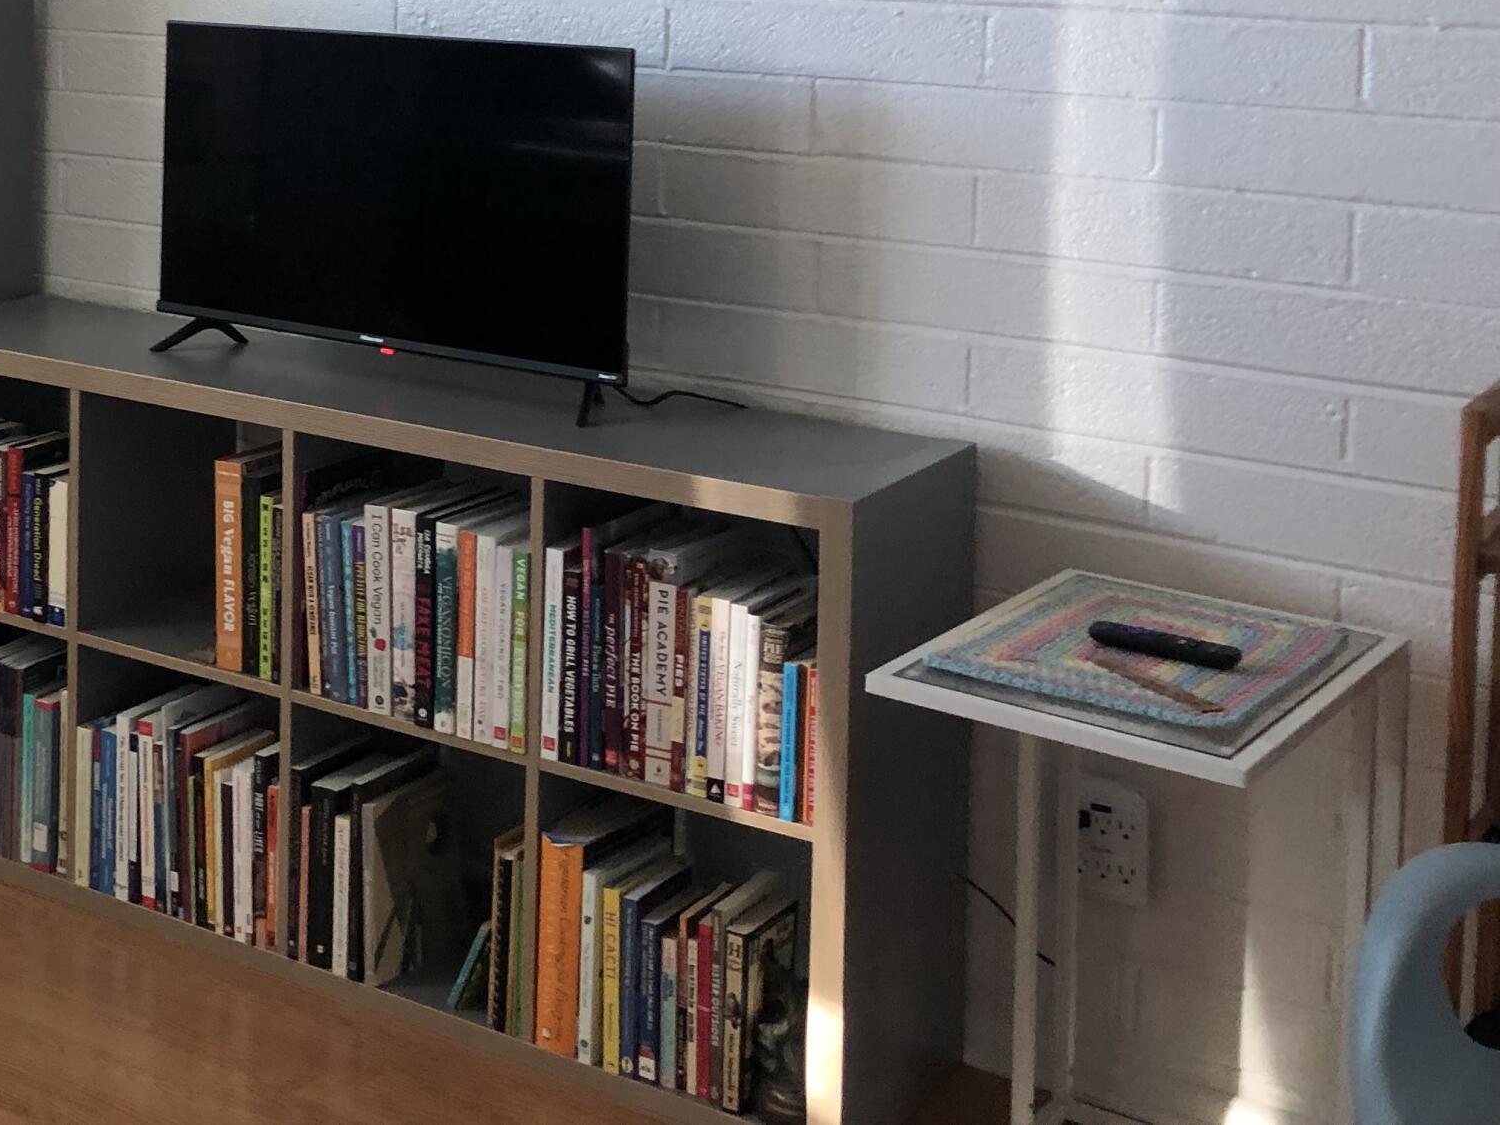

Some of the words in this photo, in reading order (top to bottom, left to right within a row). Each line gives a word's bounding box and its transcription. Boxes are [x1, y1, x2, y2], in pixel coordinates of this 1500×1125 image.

[33, 497, 42, 550] Generation
[223, 500, 234, 523] BIG
[371, 523, 382, 548] Can
[33, 552, 42, 581] Dread
[221, 529, 234, 575] Vegan
[372, 551, 384, 583] Cook
[355, 561, 366, 596] APPETITE
[515, 558, 526, 600] VEGAN
[223, 579, 234, 632] FLAVOR
[327, 584, 336, 609] Vegan
[356, 598, 366, 612] FOR
[371, 587, 383, 624] Vegan
[499, 583, 507, 614] VEGAN
[566, 595, 576, 621] HOW
[657, 589, 669, 614] PIE
[416, 597, 432, 635] FAKE
[441, 575, 453, 688] VEGANOMICON
[515, 611, 525, 635] FOR
[566, 623, 576, 637] TO
[356, 615, 366, 656] REDUCTION
[547, 604, 557, 694] MEDITERRANEAN
[700, 635, 708, 660] UNITED
[416, 641, 433, 688] MEAT
[565, 638, 575, 667] GRILL
[605, 625, 619, 680] perfect
[630, 651, 640, 673] THE
[656, 621, 668, 697] ACADEMY
[513, 647, 524, 724] EVERYBODY
[674, 654, 684, 687] PIES
[699, 663, 708, 690] STATES
[714, 664, 726, 701] VEGAN
[731, 660, 743, 712] Naturally
[497, 680, 505, 700] TWO
[564, 670, 575, 732] VEGETABLES
[605, 682, 617, 708] PIE
[630, 676, 640, 710] BOOK
[630, 713, 639, 729] ON
[698, 704, 706, 715] PIE
[714, 703, 725, 746] BAKING
[630, 733, 639, 752] PIE
[731, 715, 741, 747] Sweet
[254, 792, 263, 812] PART
[605, 912, 616, 926] HI
[554, 918, 571, 969] Cooking
[605, 934, 616, 979] CACTI
[712, 964, 720, 995] SISTER
[711, 997, 720, 1046] OUTSIDER
